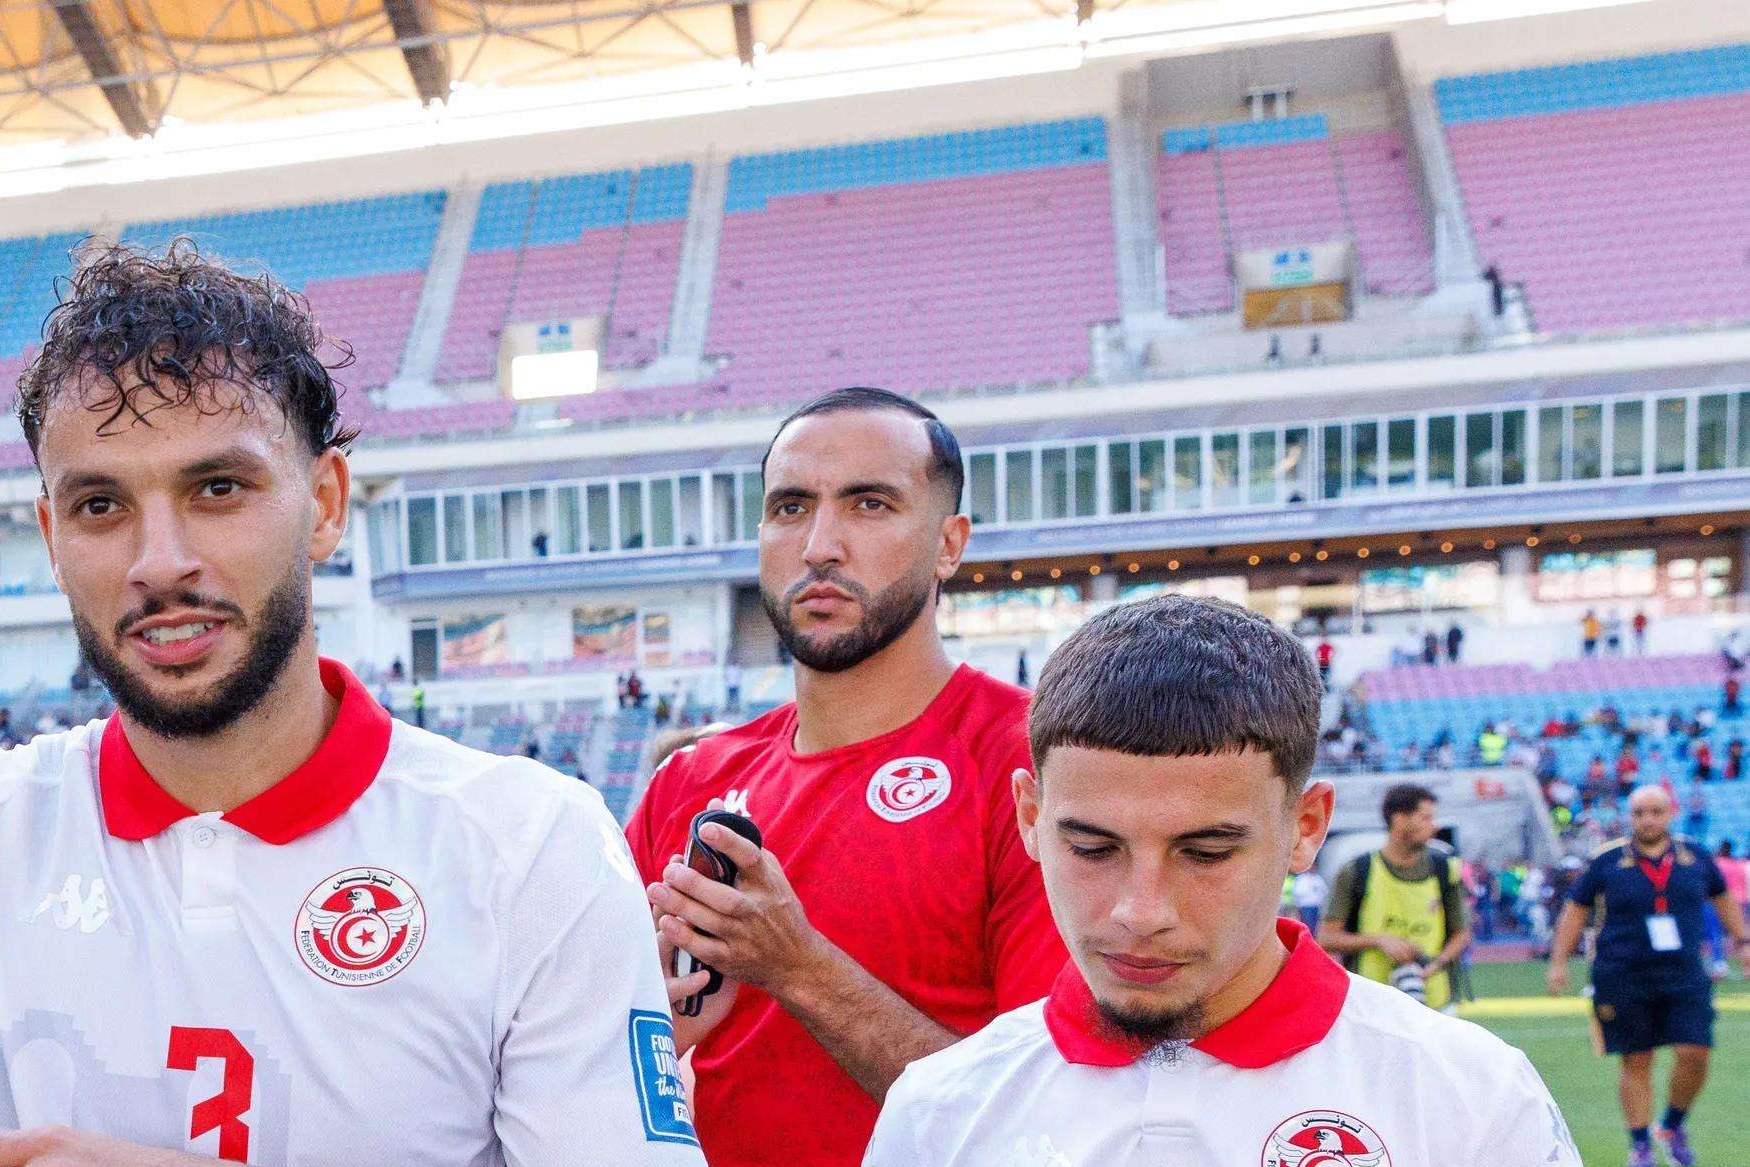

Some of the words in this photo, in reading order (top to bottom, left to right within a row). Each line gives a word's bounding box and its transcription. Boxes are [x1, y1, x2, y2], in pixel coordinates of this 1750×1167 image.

[333, 870, 395, 890] تونس
[301, 930, 332, 973] FEDERATION
[331, 968, 385, 982] TUNISIENNE
[385, 961, 398, 973] DE
[395, 925, 420, 964] FOOTBALL
[166, 1026, 254, 1164] 3
[1301, 1115, 1364, 1134] تونس
